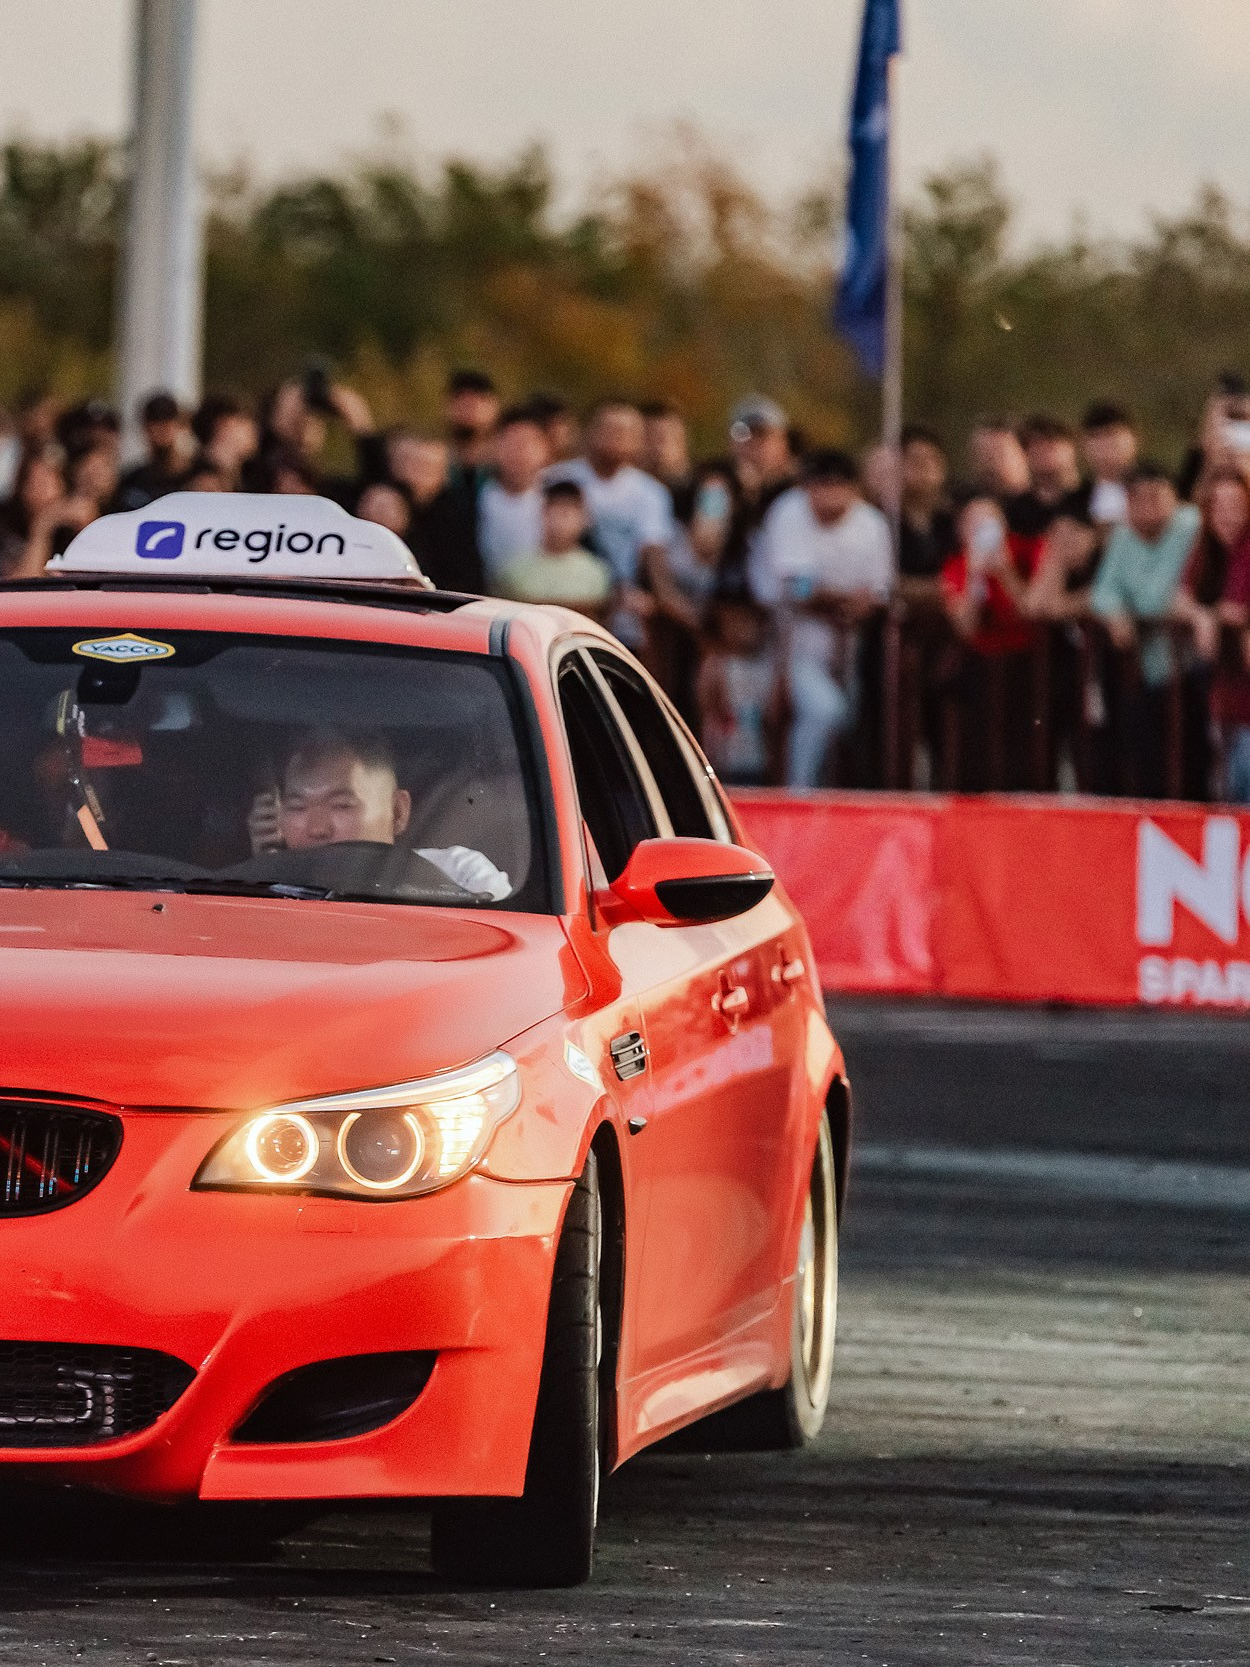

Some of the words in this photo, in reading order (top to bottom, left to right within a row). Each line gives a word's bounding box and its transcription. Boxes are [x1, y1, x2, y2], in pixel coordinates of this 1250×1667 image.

[196, 524, 345, 562] region
[91, 644, 159, 654] YACCO
[1136, 813, 1250, 948] N
